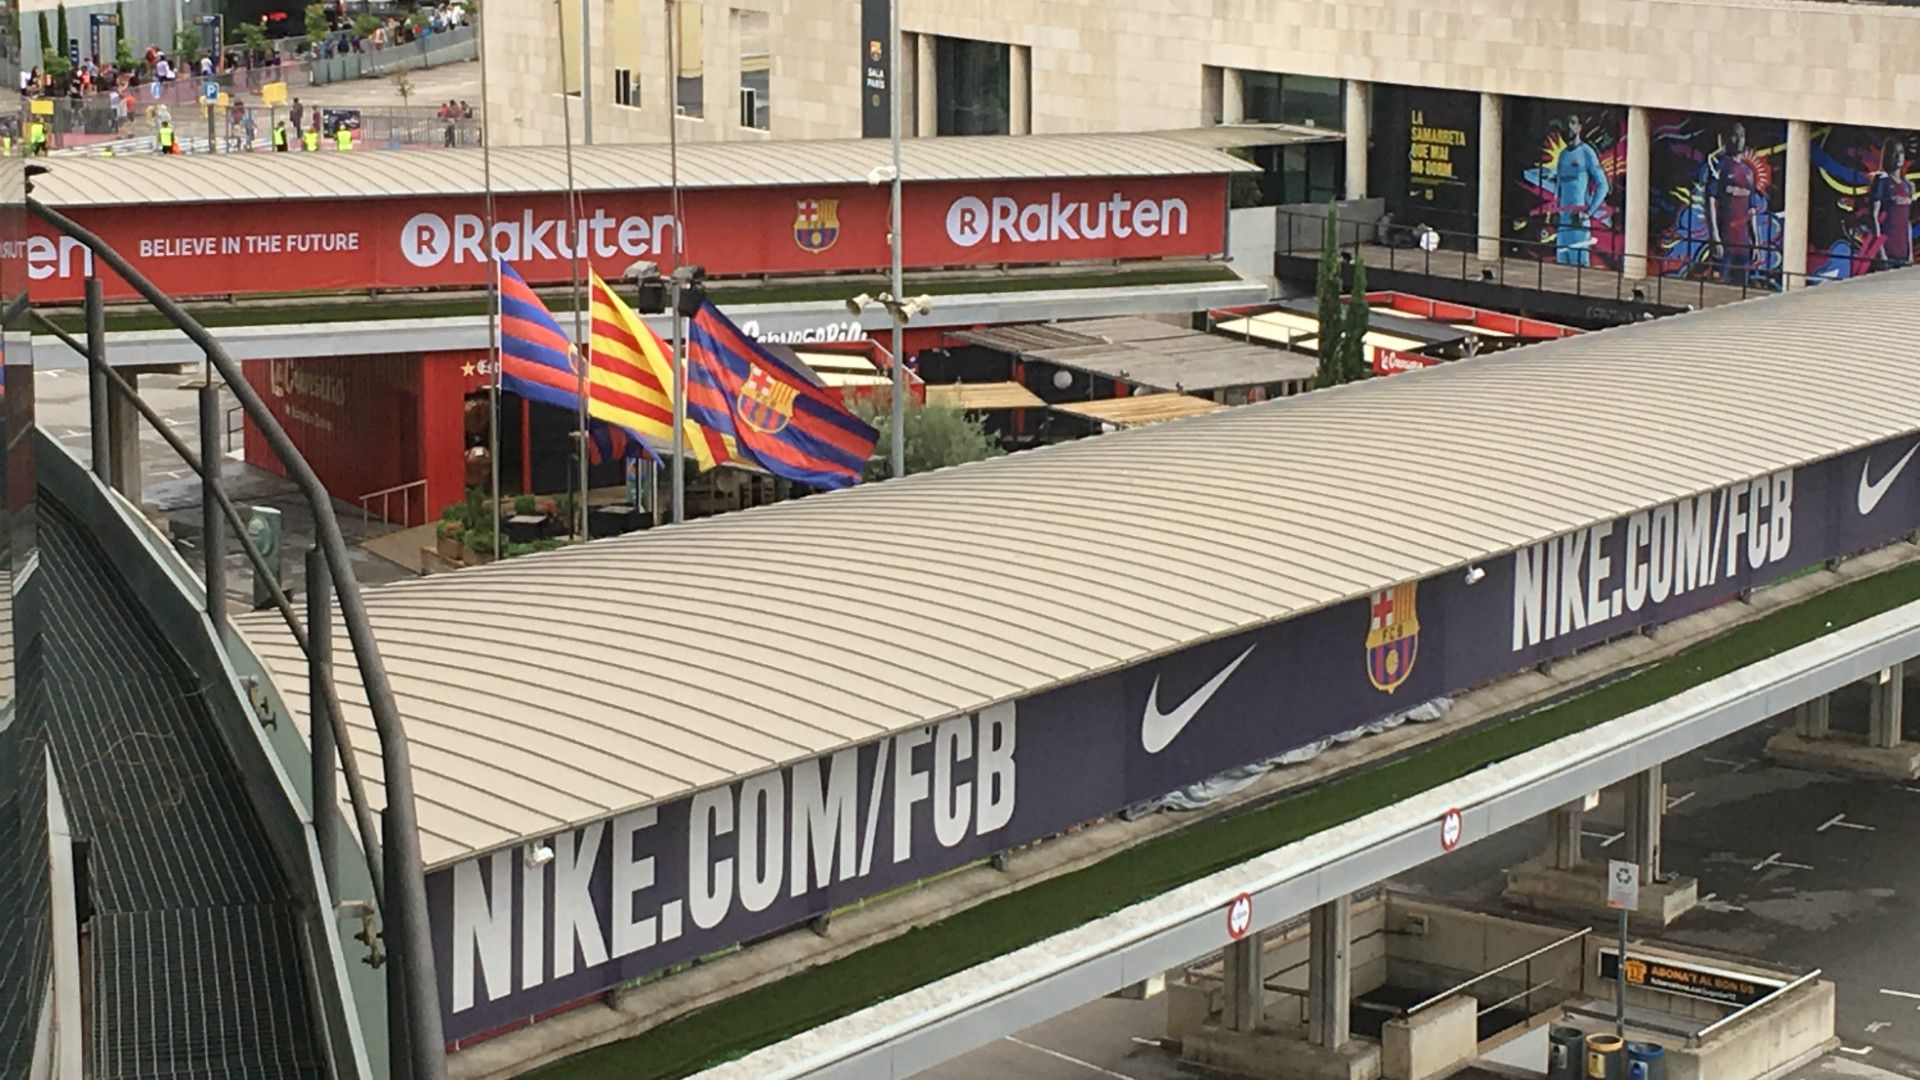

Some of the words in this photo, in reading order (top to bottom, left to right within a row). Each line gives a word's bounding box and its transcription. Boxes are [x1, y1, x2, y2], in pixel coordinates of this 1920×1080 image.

[868, 67, 884, 78] SALA
[139, 237, 217, 257] BELIEVE
[221, 236, 241, 254] IN
[245, 234, 282, 254] THE
[286, 231, 359, 252] FUTURE
[453, 208, 683, 264] Rakuten
[991, 192, 1188, 244] Rakuten
[1512, 467, 1794, 652] NIKE.COM/FCB
[1382, 624, 1404, 642] FCB
[452, 699, 1017, 1014] NIKE.COM/FCB
